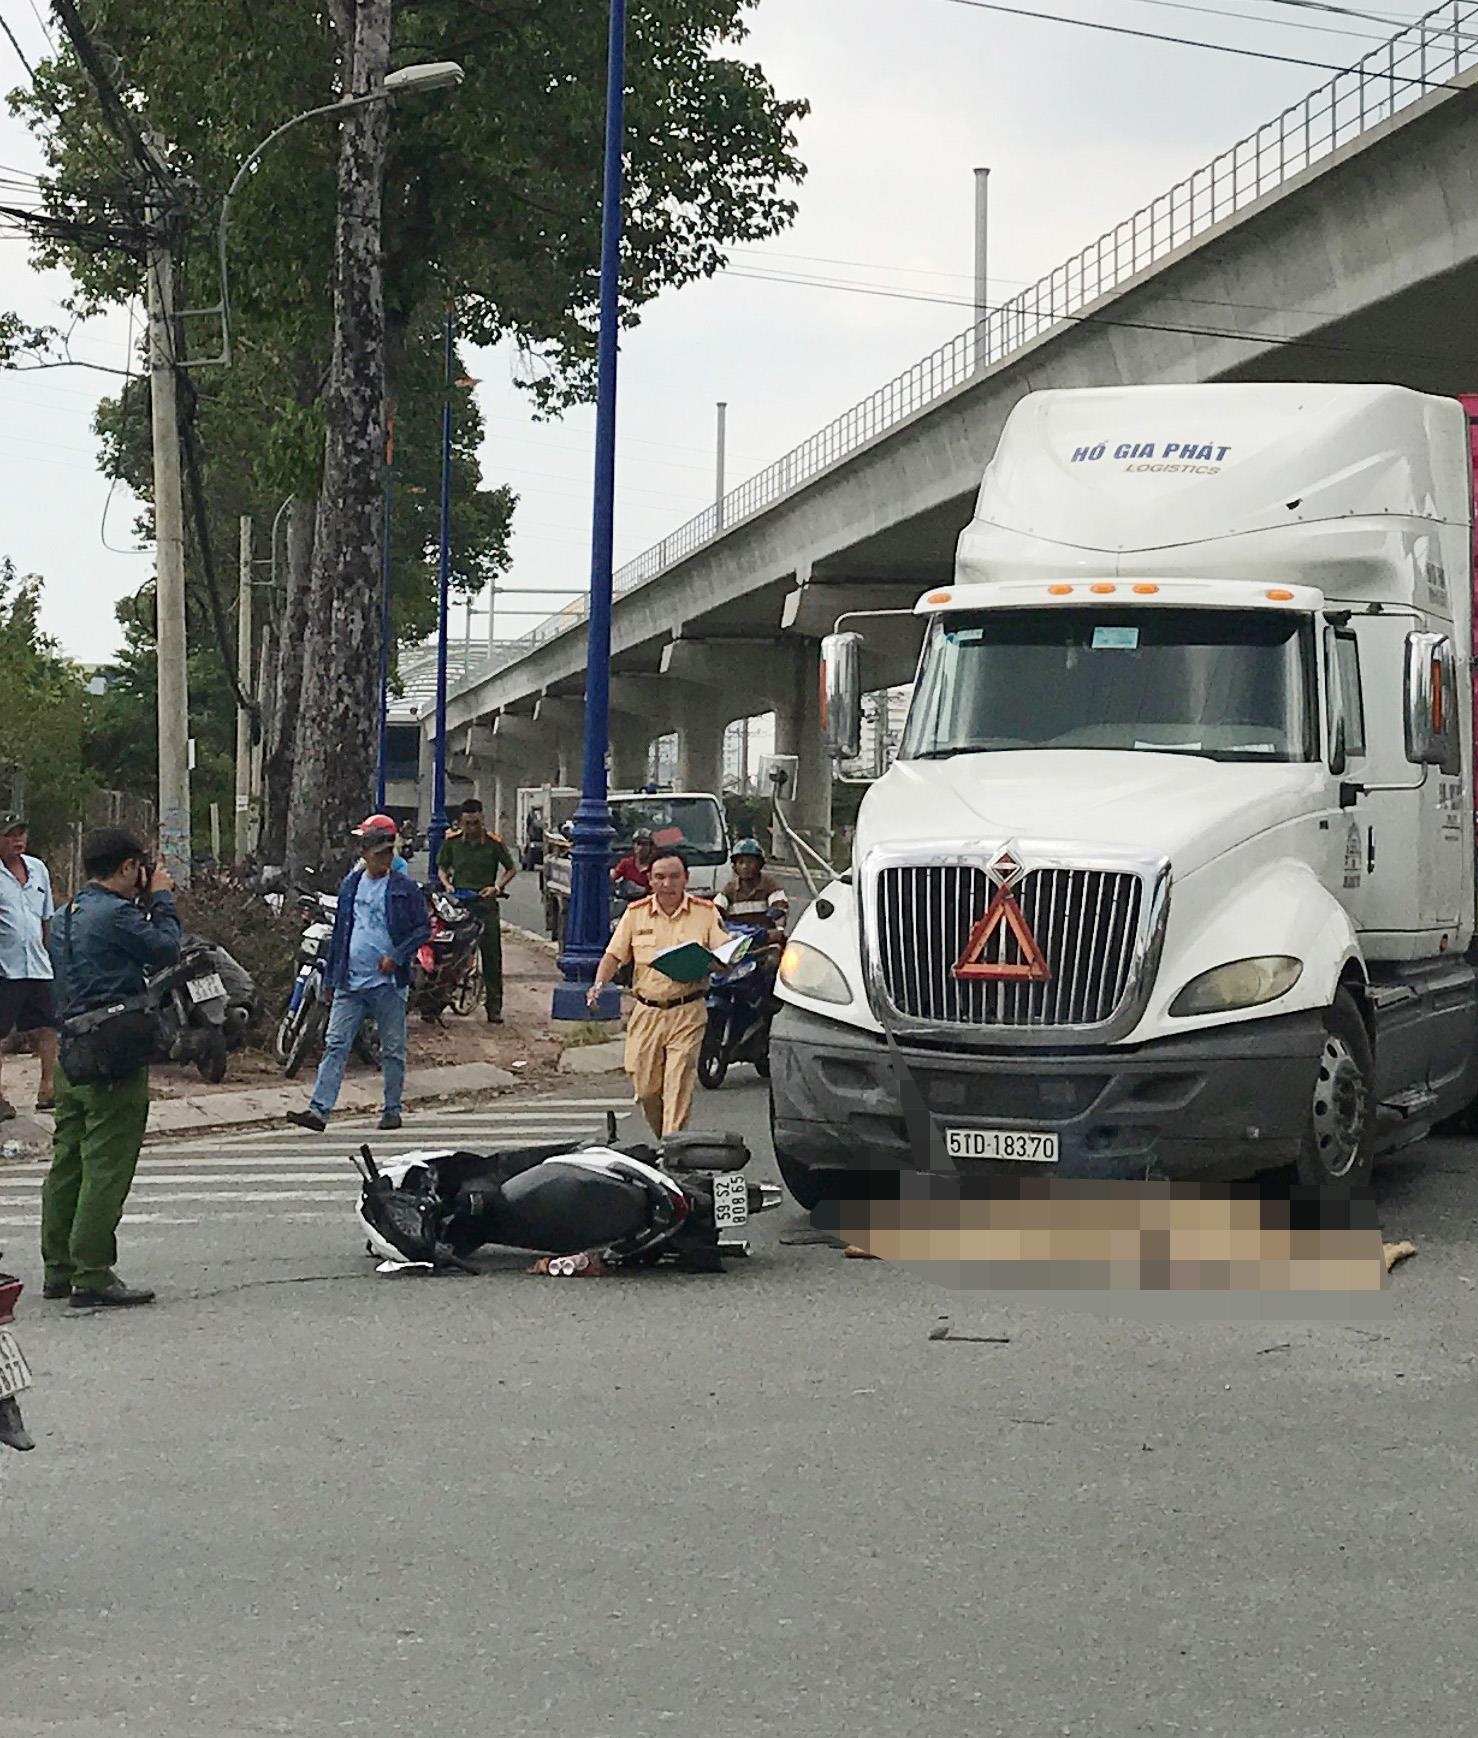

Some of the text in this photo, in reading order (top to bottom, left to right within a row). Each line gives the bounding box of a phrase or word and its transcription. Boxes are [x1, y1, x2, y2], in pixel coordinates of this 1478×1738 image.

[1113, 443, 1155, 460] GIA
[1162, 441, 1232, 462] PHÁT
[1124, 463, 1221, 475] LOGISTICS
